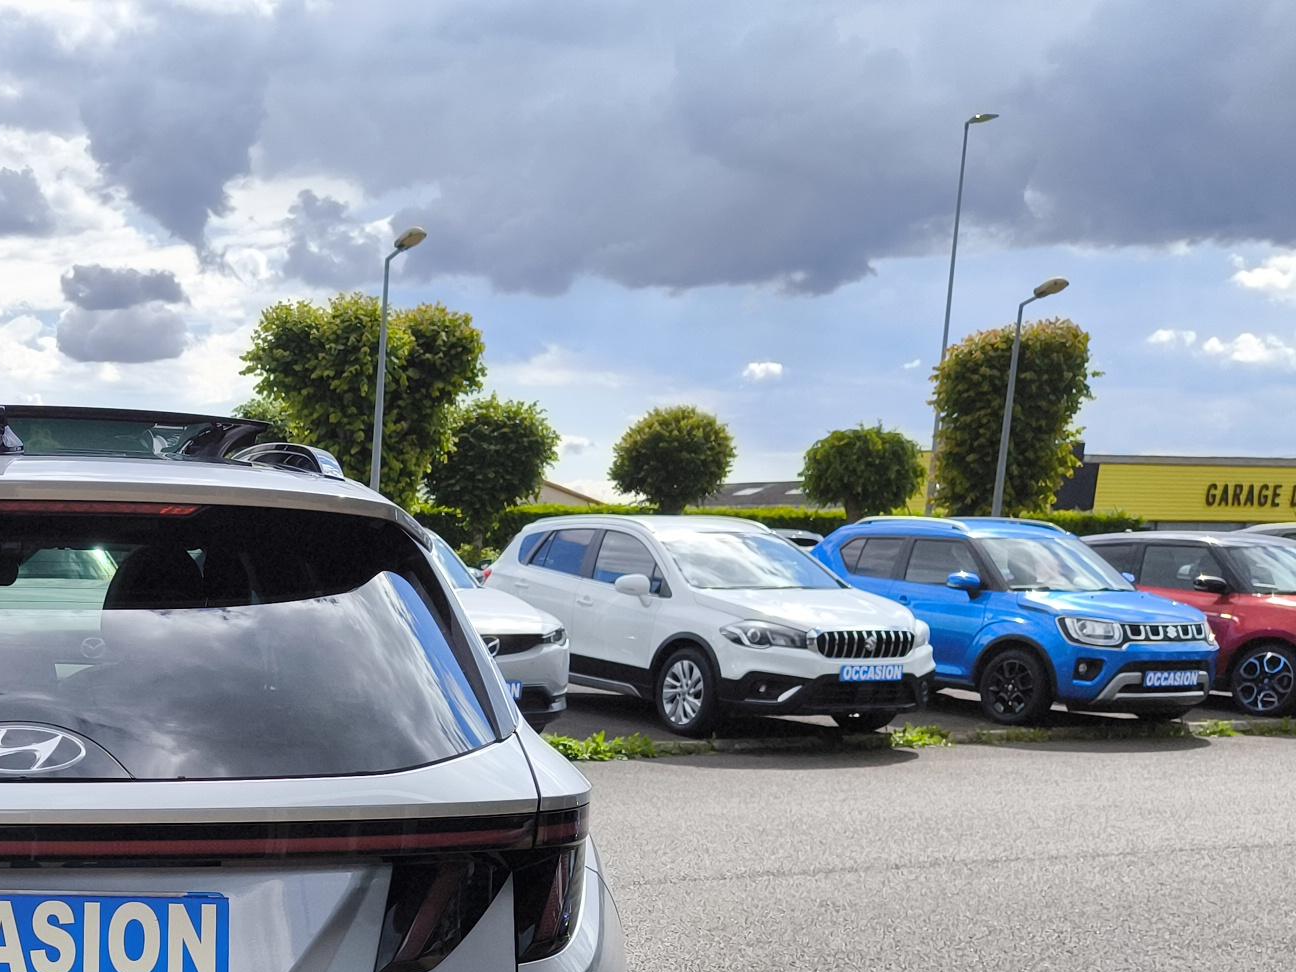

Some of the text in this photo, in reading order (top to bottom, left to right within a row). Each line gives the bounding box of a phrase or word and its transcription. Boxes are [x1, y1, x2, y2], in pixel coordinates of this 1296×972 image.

[1205, 483, 1283, 507] GARAGE
[842, 665, 903, 680] OCCASION
[1146, 671, 1199, 686] OCCASION
